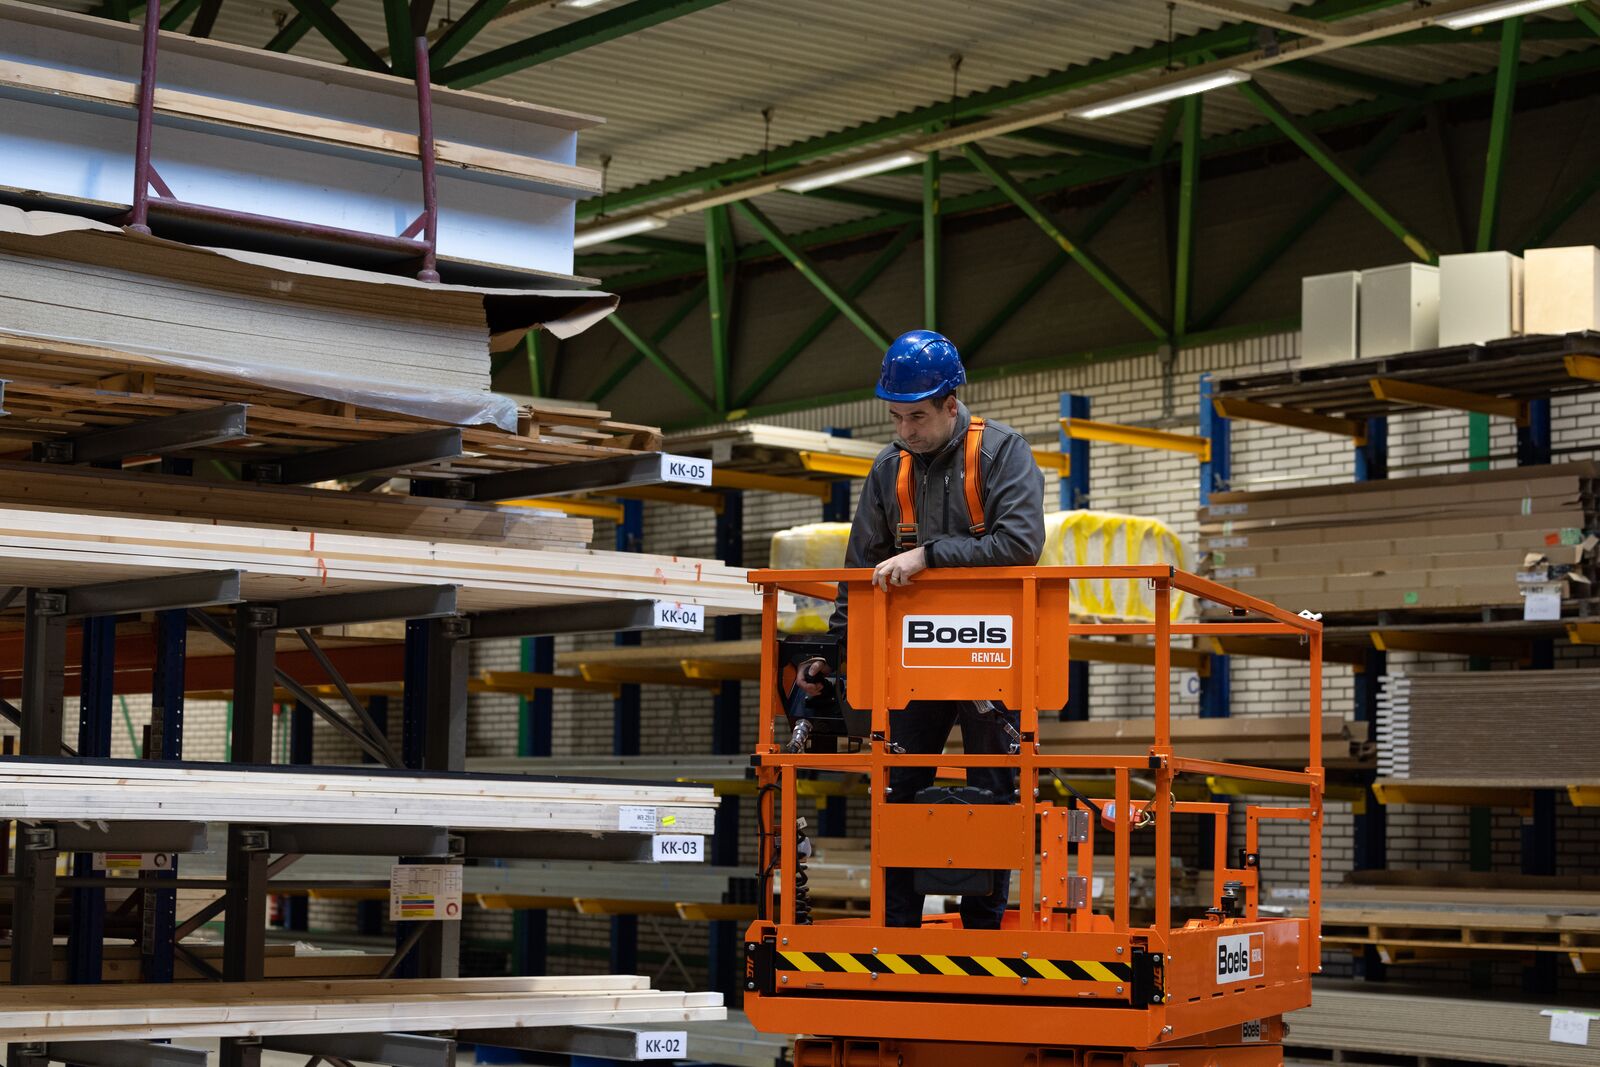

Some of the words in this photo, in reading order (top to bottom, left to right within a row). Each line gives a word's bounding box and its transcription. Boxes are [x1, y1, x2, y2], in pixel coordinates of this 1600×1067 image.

[670, 462, 705, 479] KK-05
[661, 609, 697, 625] KK-04
[908, 621, 1007, 643] Boels
[971, 652, 1007, 663] RENTAL
[661, 841, 697, 855] KK-03
[746, 955, 754, 978] JLG
[1218, 942, 1248, 975] Boels
[1153, 966, 1162, 991] JLG
[1243, 1019, 1260, 1037] Boels
[645, 1039, 680, 1053] KK-02
